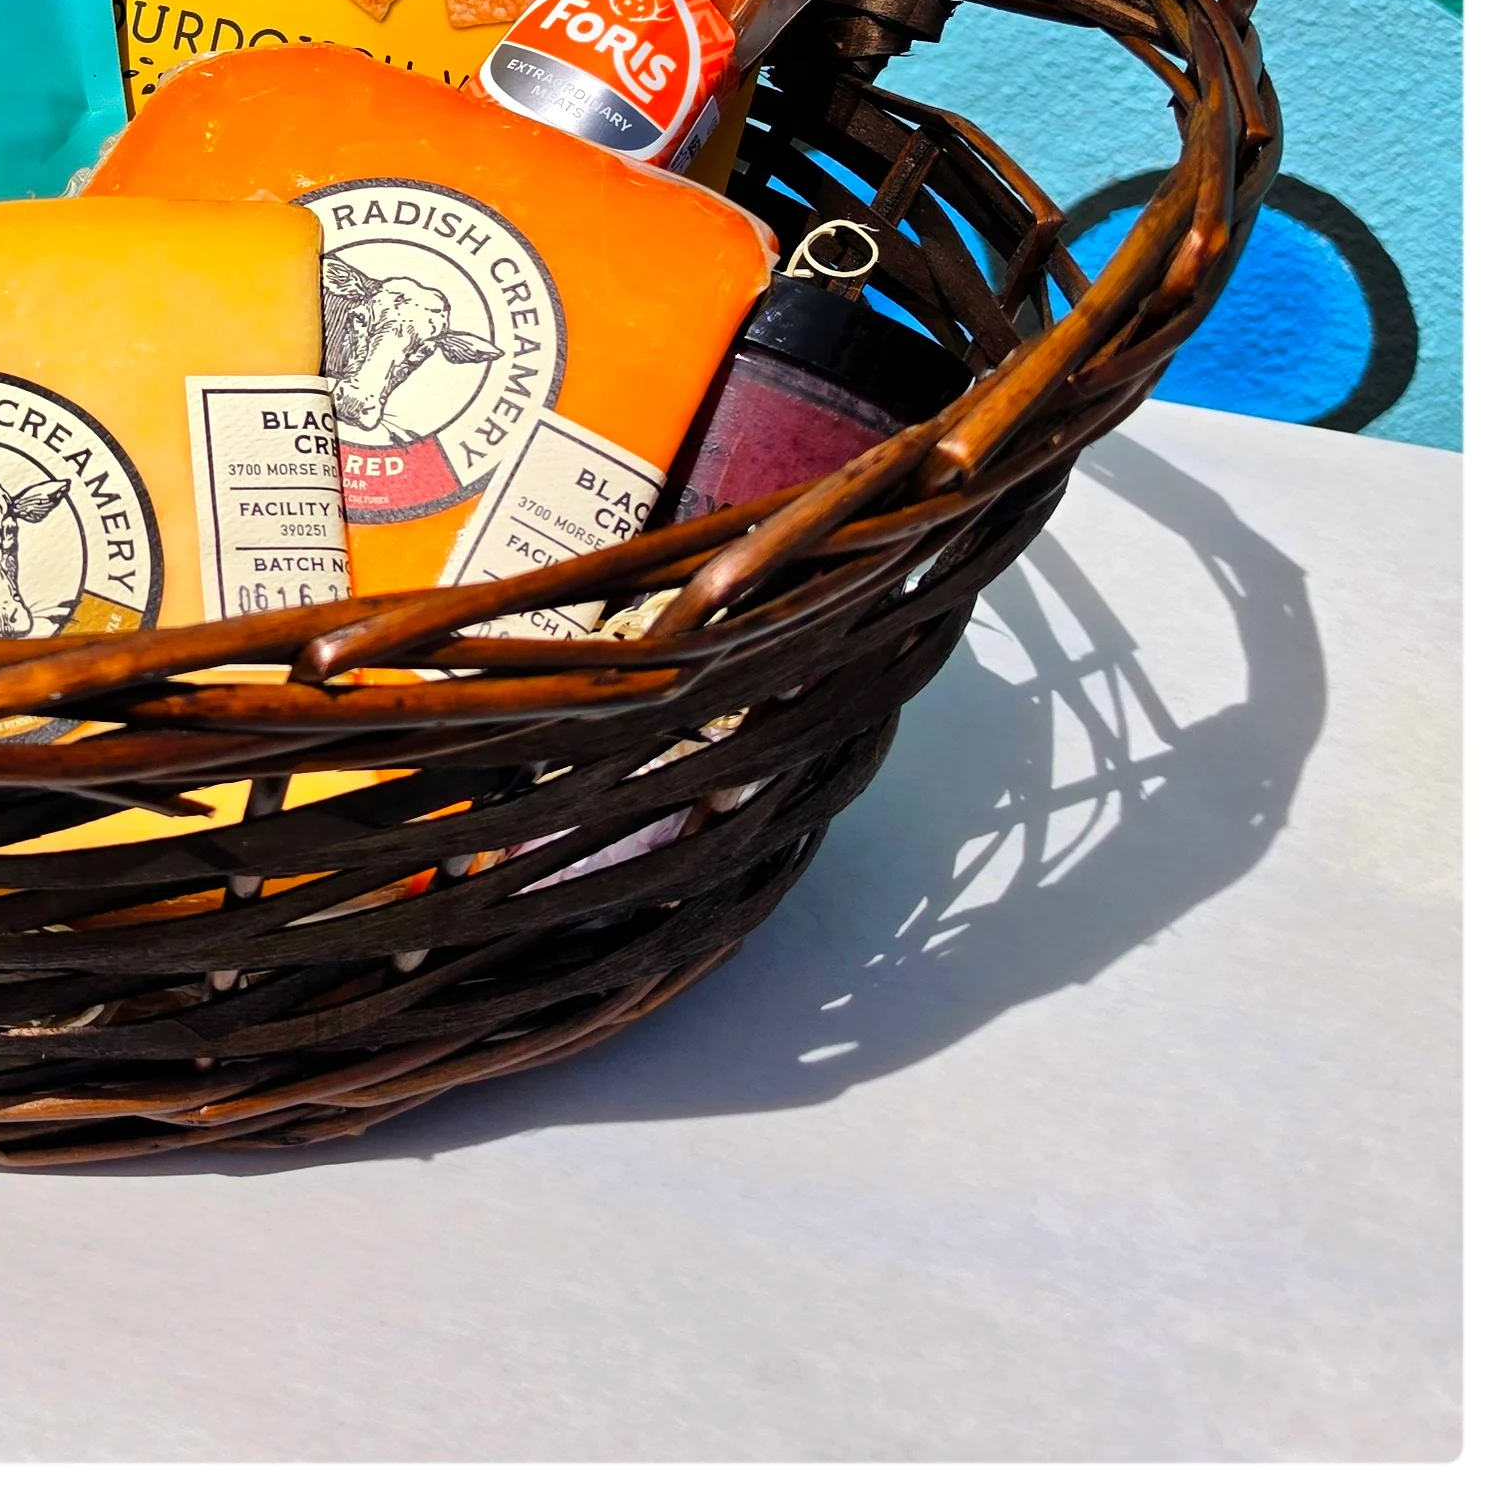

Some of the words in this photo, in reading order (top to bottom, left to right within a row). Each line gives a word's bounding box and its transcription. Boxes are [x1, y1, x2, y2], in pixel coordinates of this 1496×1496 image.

[530, 84, 585, 120] MEATS
[331, 199, 493, 257] RADISH
[459, 256, 542, 471] CREAMERY
[228, 463, 262, 477] 3700
[267, 463, 319, 477] MORSE
[343, 453, 405, 477] RED
[239, 501, 331, 518] FACILITY
[280, 524, 327, 538] 390251
[517, 495, 552, 522] 3700
[553, 515, 606, 551] MORSE
[253, 557, 325, 573] BATCH
